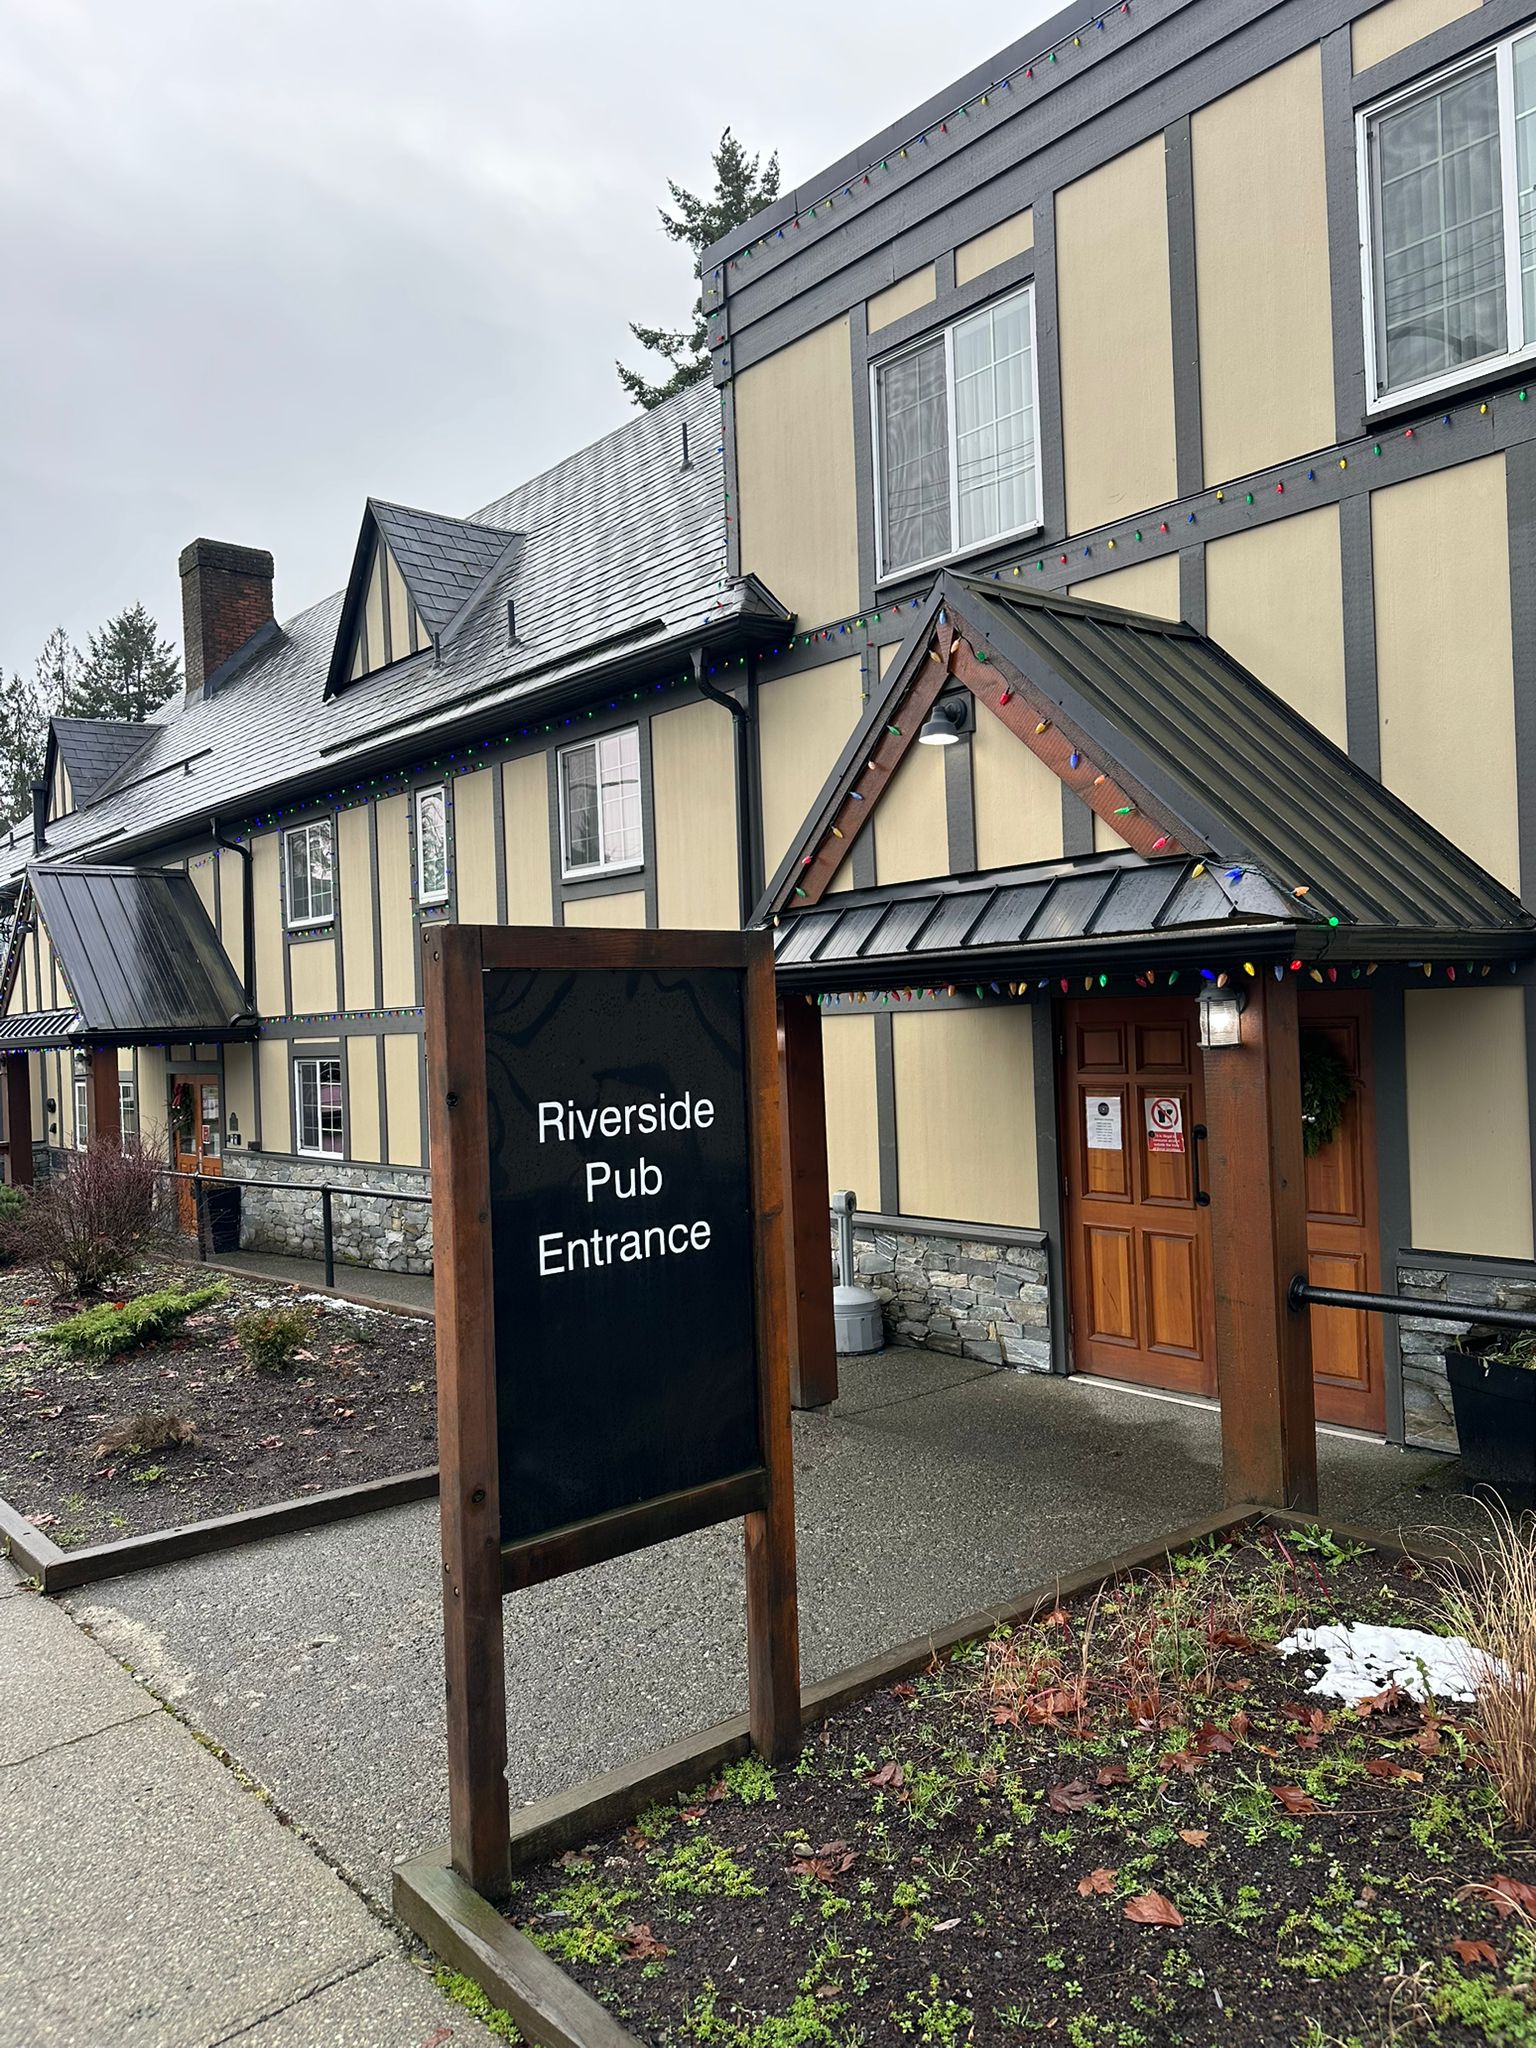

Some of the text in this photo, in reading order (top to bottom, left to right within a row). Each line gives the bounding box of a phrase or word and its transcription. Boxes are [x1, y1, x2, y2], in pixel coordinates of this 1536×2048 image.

[538, 1090, 715, 1144] Riverside
[585, 1156, 663, 1203] Pub
[538, 1220, 711, 1277] Entrance
